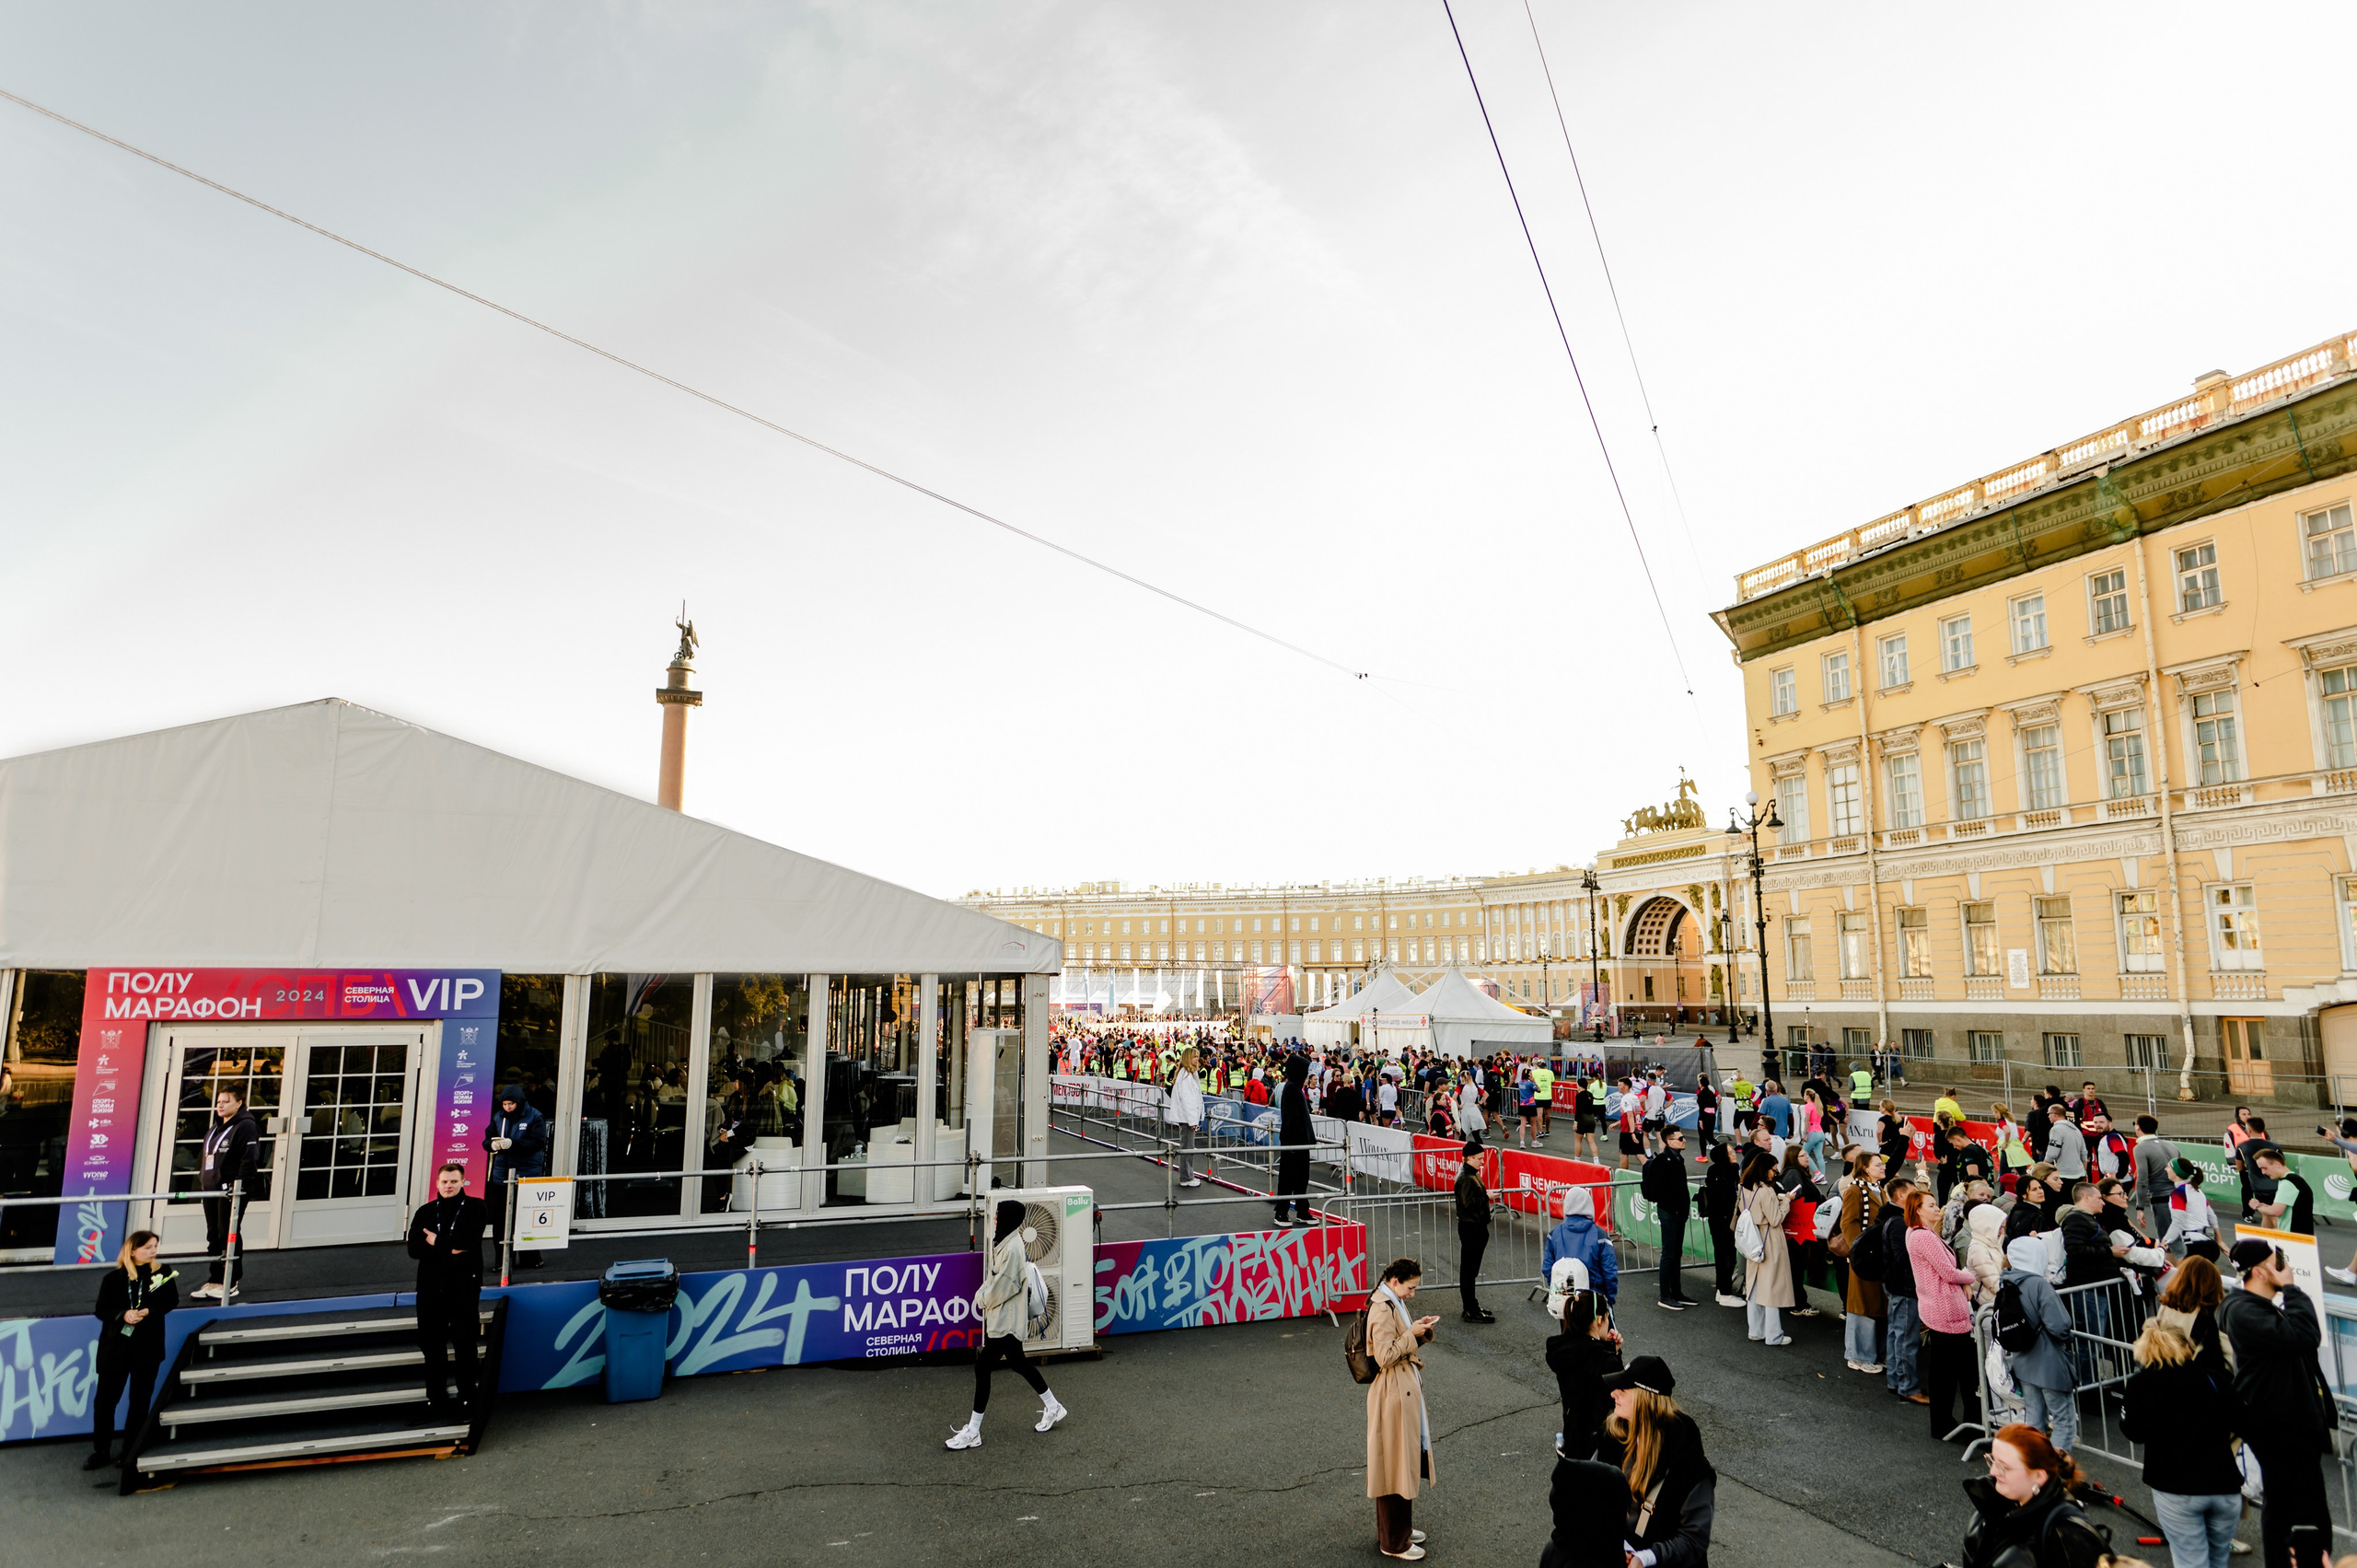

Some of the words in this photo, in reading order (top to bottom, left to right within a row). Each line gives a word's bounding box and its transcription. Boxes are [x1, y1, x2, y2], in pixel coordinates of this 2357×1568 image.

[108, 972, 193, 993] ПОЛУ
[276, 990, 324, 1002] 2024
[344, 986, 395, 995] СЕВЕРНАЯ
[407, 978, 484, 1011] VIP
[344, 994, 390, 1004] СТОЛИЦА
[104, 997, 262, 1018] МАРАФОН
[536, 1191, 556, 1202] VIP
[1067, 1197, 1088, 1206] Ballu
[539, 1212, 548, 1225] 6
[845, 1262, 942, 1297] ПОЛУ
[865, 1332, 923, 1347] СЕВЕРНАЯ
[865, 1344, 918, 1358] СТОЛИЦА
